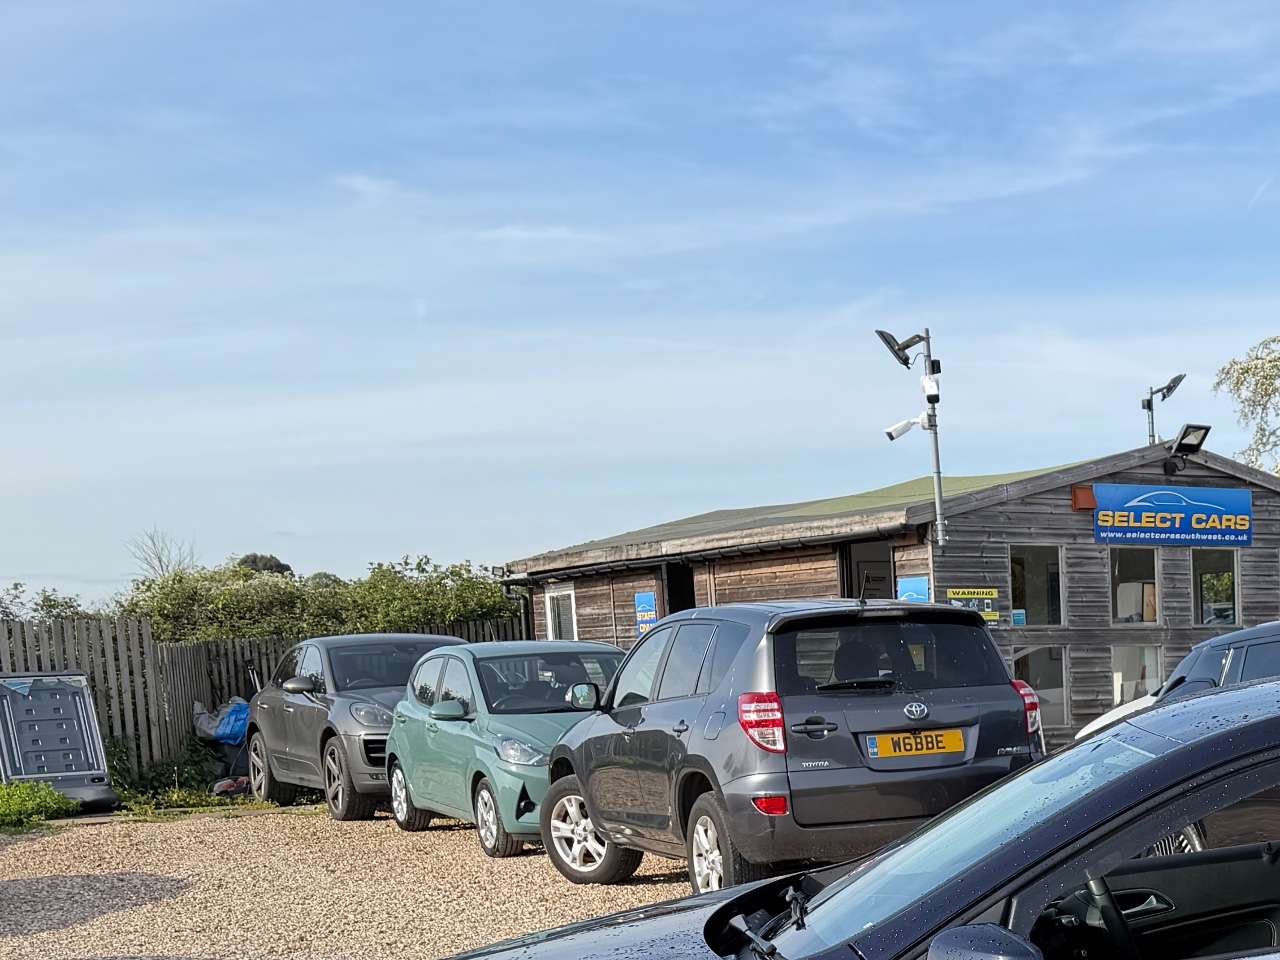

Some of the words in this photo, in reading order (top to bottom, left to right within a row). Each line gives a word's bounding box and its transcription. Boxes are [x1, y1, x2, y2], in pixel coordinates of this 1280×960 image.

[1097, 510, 1185, 528] SELECT
[1191, 513, 1250, 530] CARS
[1100, 531, 1249, 541] www.selectcarssouthwest.co.uk
[891, 734, 946, 753] W6BBE
